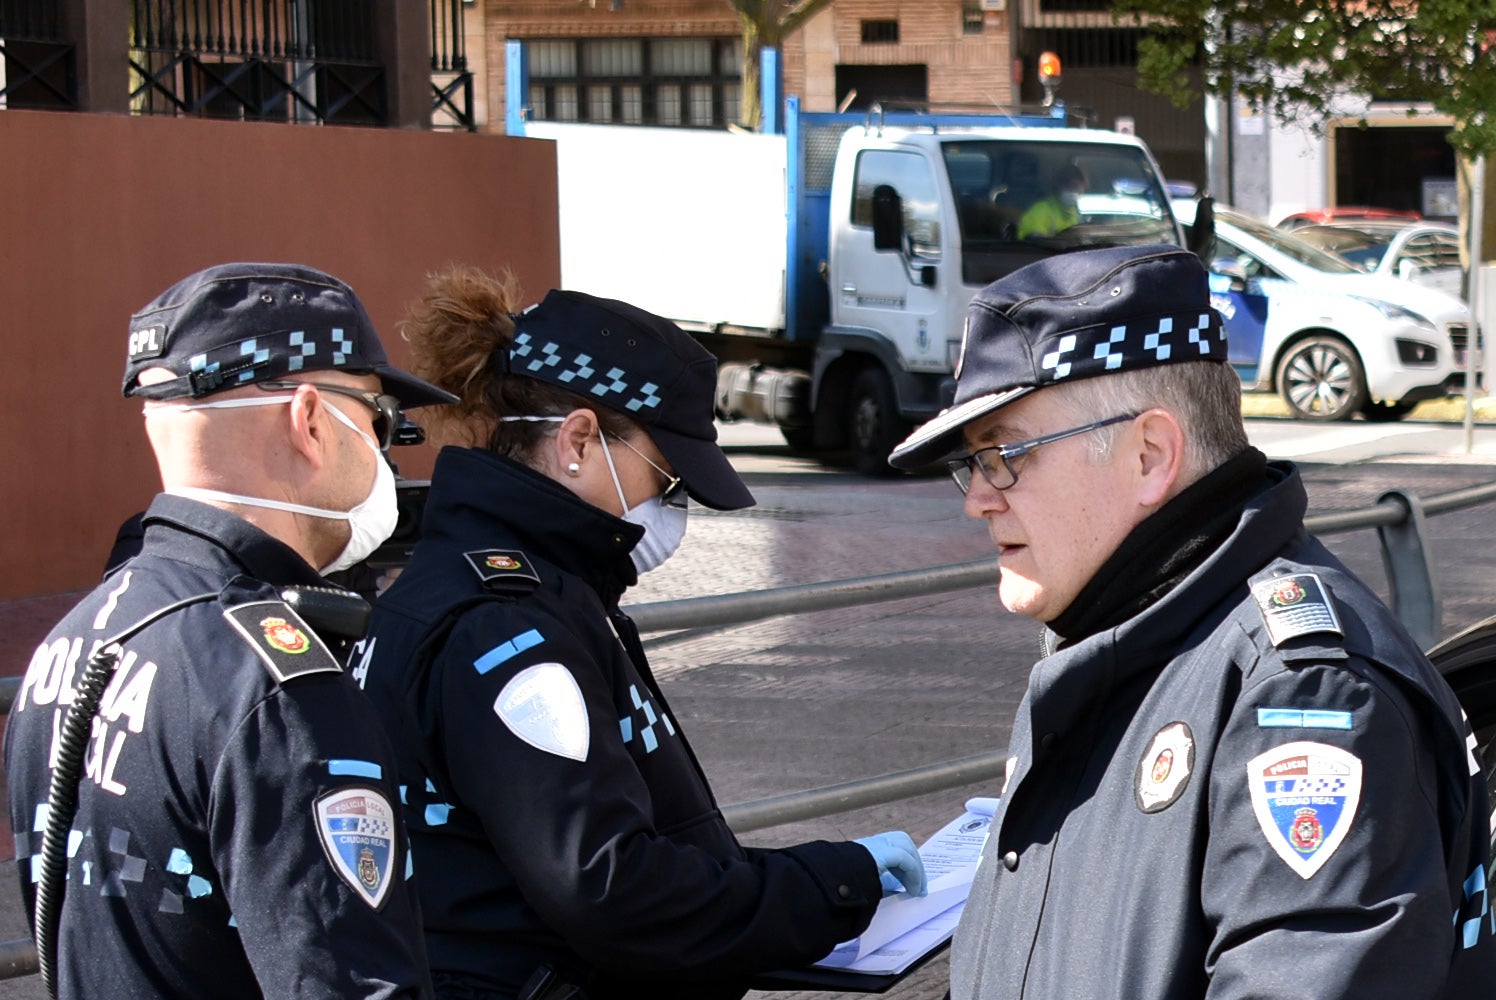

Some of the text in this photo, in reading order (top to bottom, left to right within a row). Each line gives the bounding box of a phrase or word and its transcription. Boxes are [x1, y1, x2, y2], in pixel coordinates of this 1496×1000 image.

[129, 328, 159, 356] CPL
[1270, 760, 1307, 775] POLICIA
[336, 800, 385, 816] POLICIA LOCAL
[340, 835, 387, 847] CIUDAD REAL
